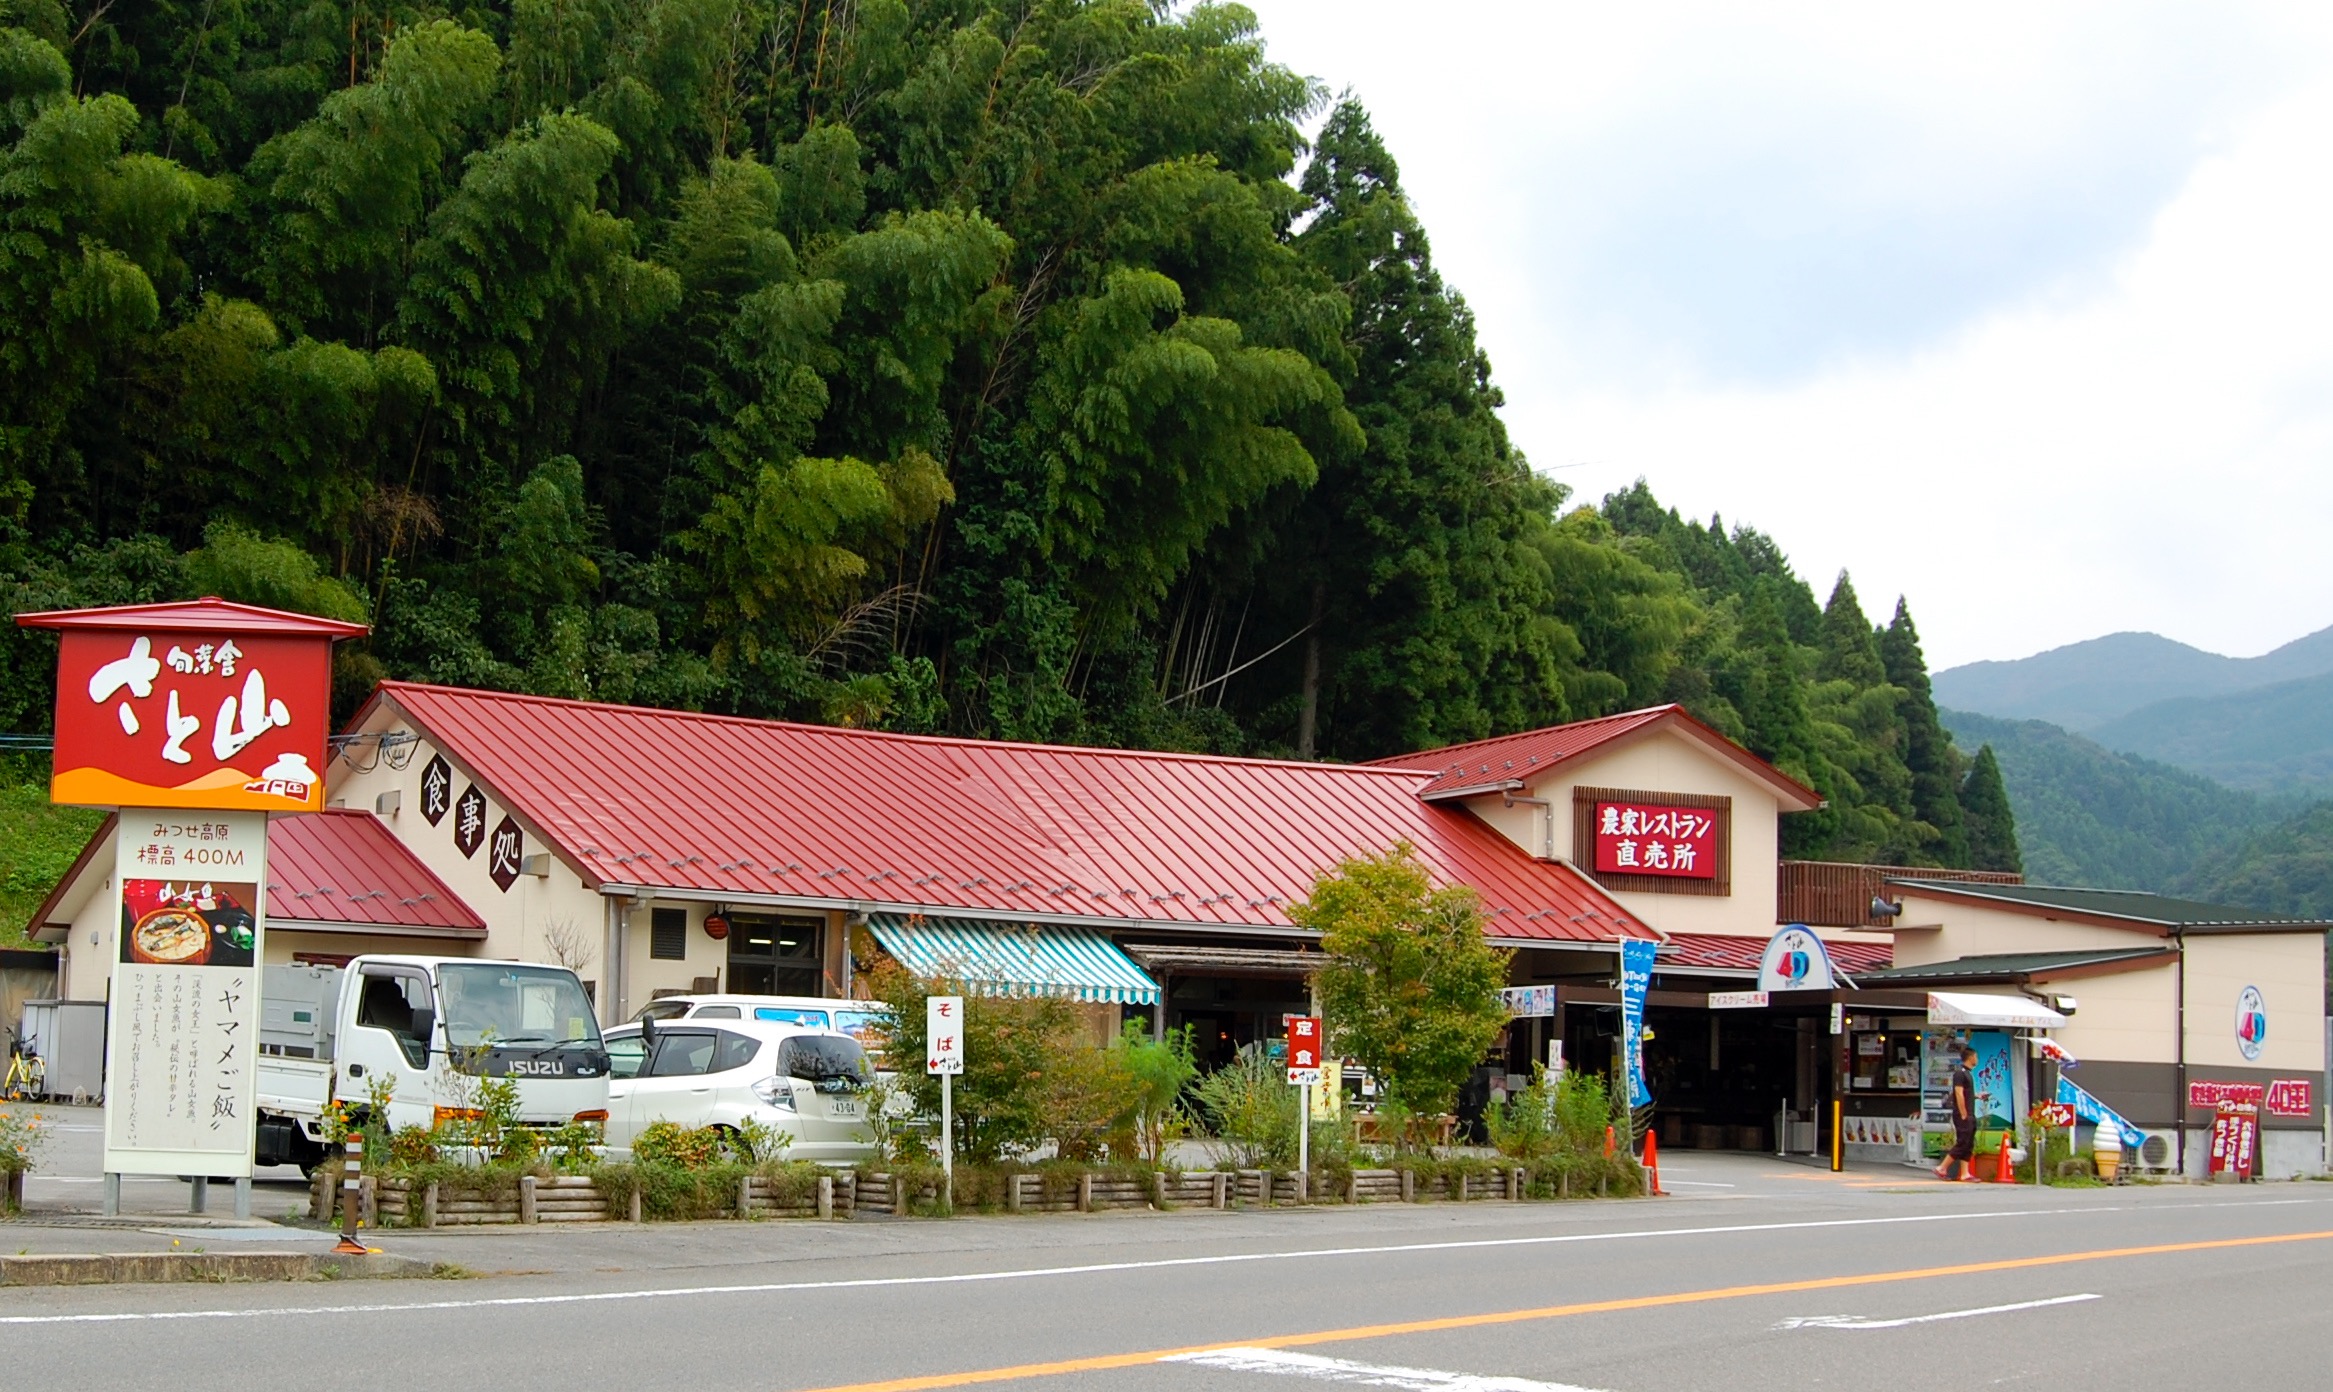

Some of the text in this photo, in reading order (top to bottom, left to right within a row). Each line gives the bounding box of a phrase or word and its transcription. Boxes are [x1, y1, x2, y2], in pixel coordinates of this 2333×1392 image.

[167, 639, 243, 676] 旬菜舎
[88, 636, 291, 764] さと山
[153, 822, 229, 841] みつせ高原
[423, 762, 518, 876] 食事処
[1600, 806, 1711, 839] 農家レストラン
[137, 844, 244, 866] 標高 400M
[1616, 839, 1697, 871] 直売所
[937, 1003, 954, 1051] そば
[1296, 1021, 1313, 1065] 定食
[508, 1060, 564, 1076] ISUZU
